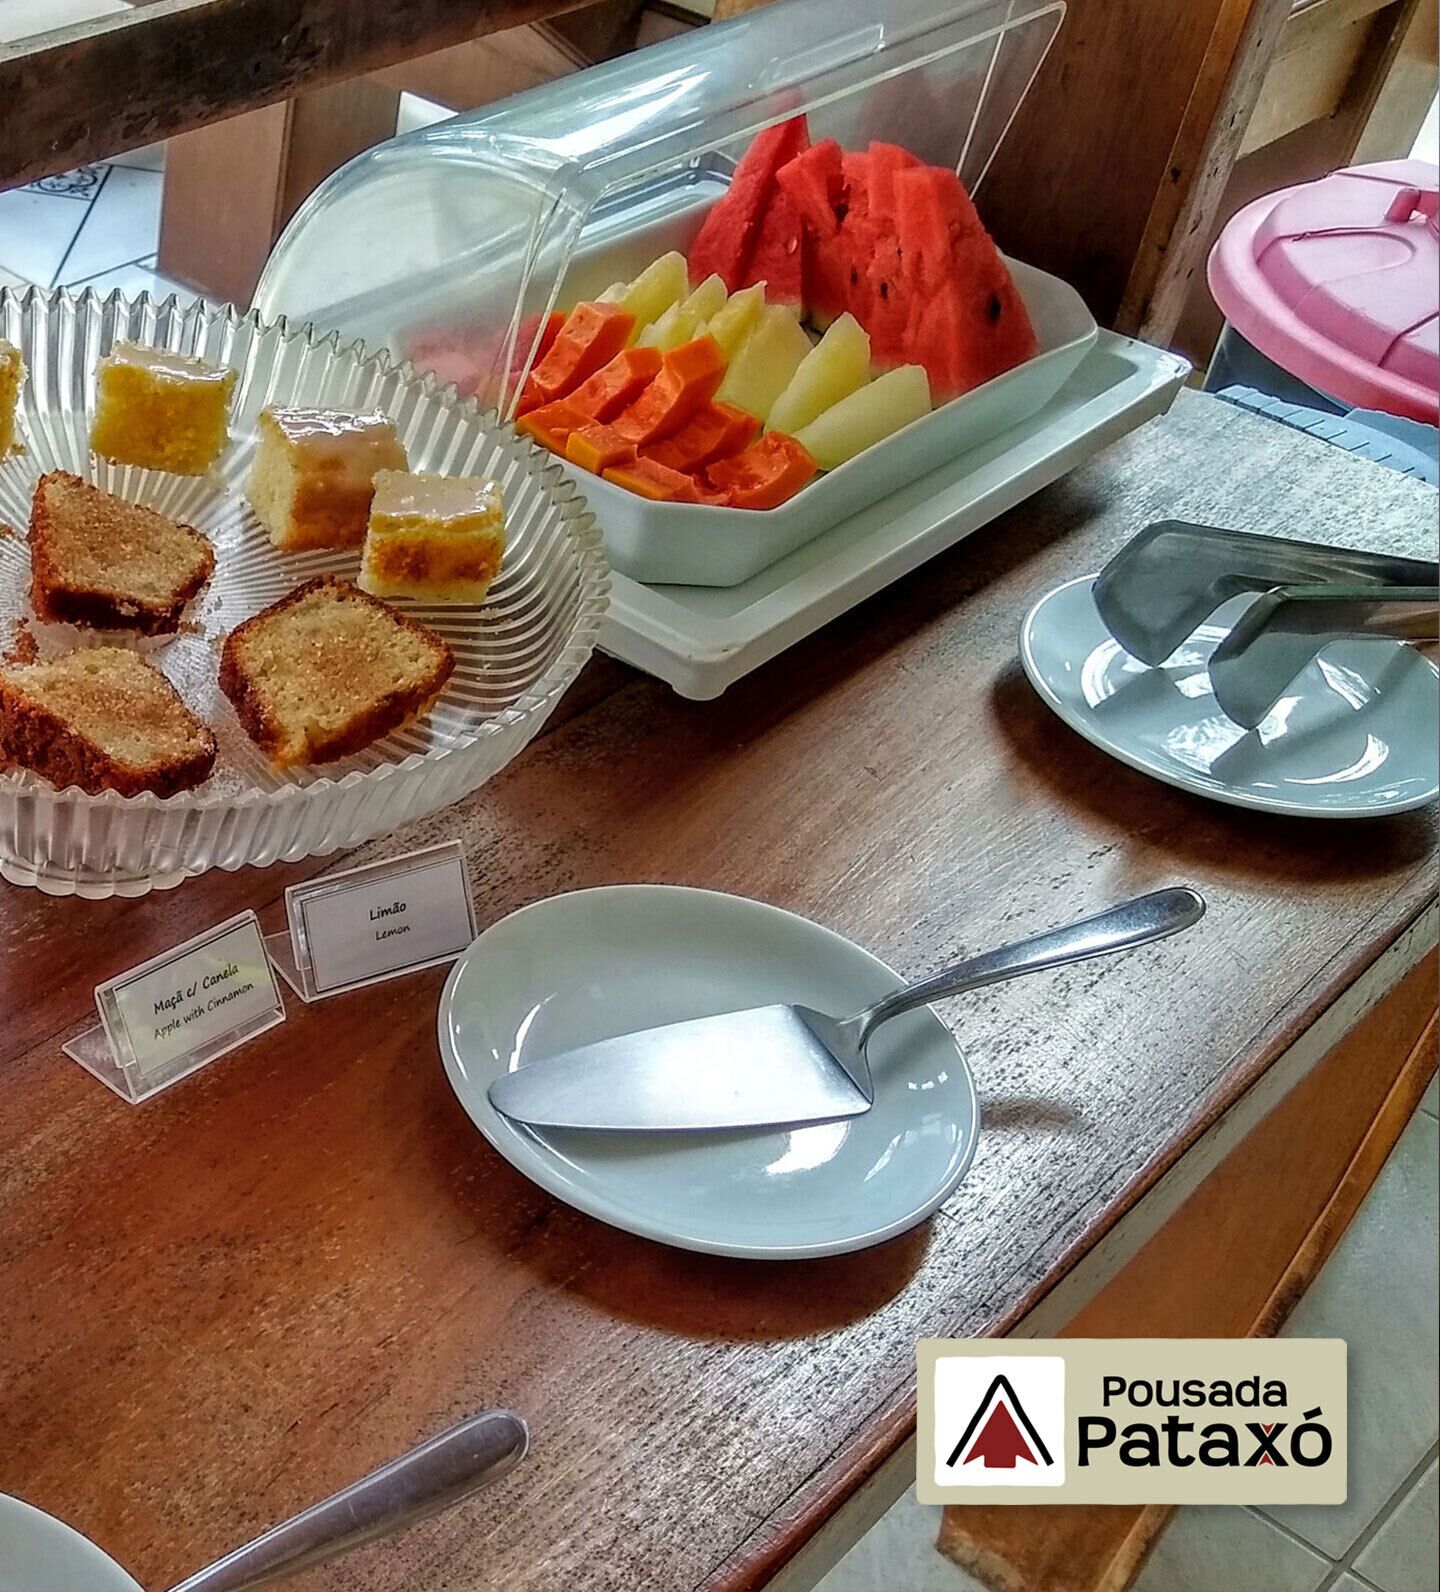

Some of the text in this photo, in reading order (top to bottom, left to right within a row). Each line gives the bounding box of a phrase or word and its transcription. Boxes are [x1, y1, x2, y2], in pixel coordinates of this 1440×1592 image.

[369, 901, 407, 921] Limão
[375, 924, 411, 941] Lemon
[153, 963, 240, 1015] Maçã c/ Canela
[153, 982, 254, 1040] Apple with Cinnamon
